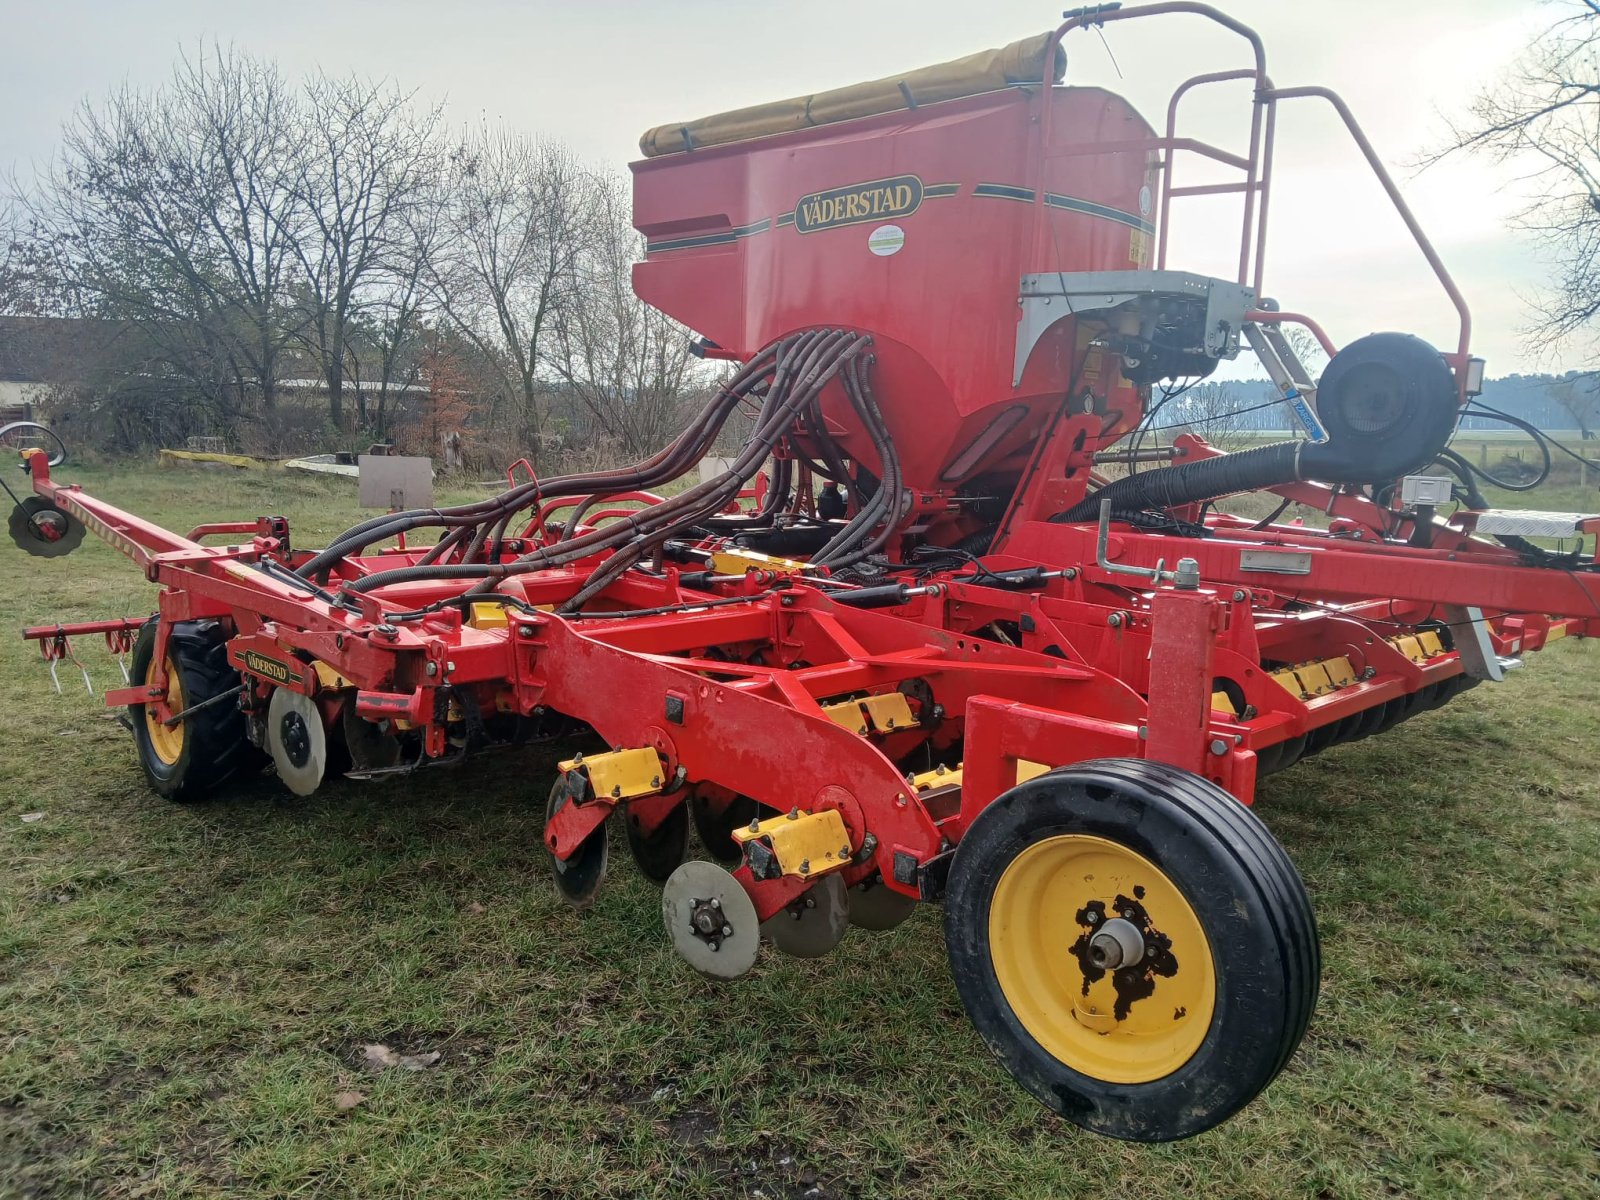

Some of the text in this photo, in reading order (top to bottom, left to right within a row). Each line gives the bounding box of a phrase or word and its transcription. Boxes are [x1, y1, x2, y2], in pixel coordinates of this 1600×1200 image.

[802, 184, 913, 226] VÄDERSTAD
[1295, 402, 1317, 432] ZARGES
[247, 654, 287, 680] VÄDERSTAD
